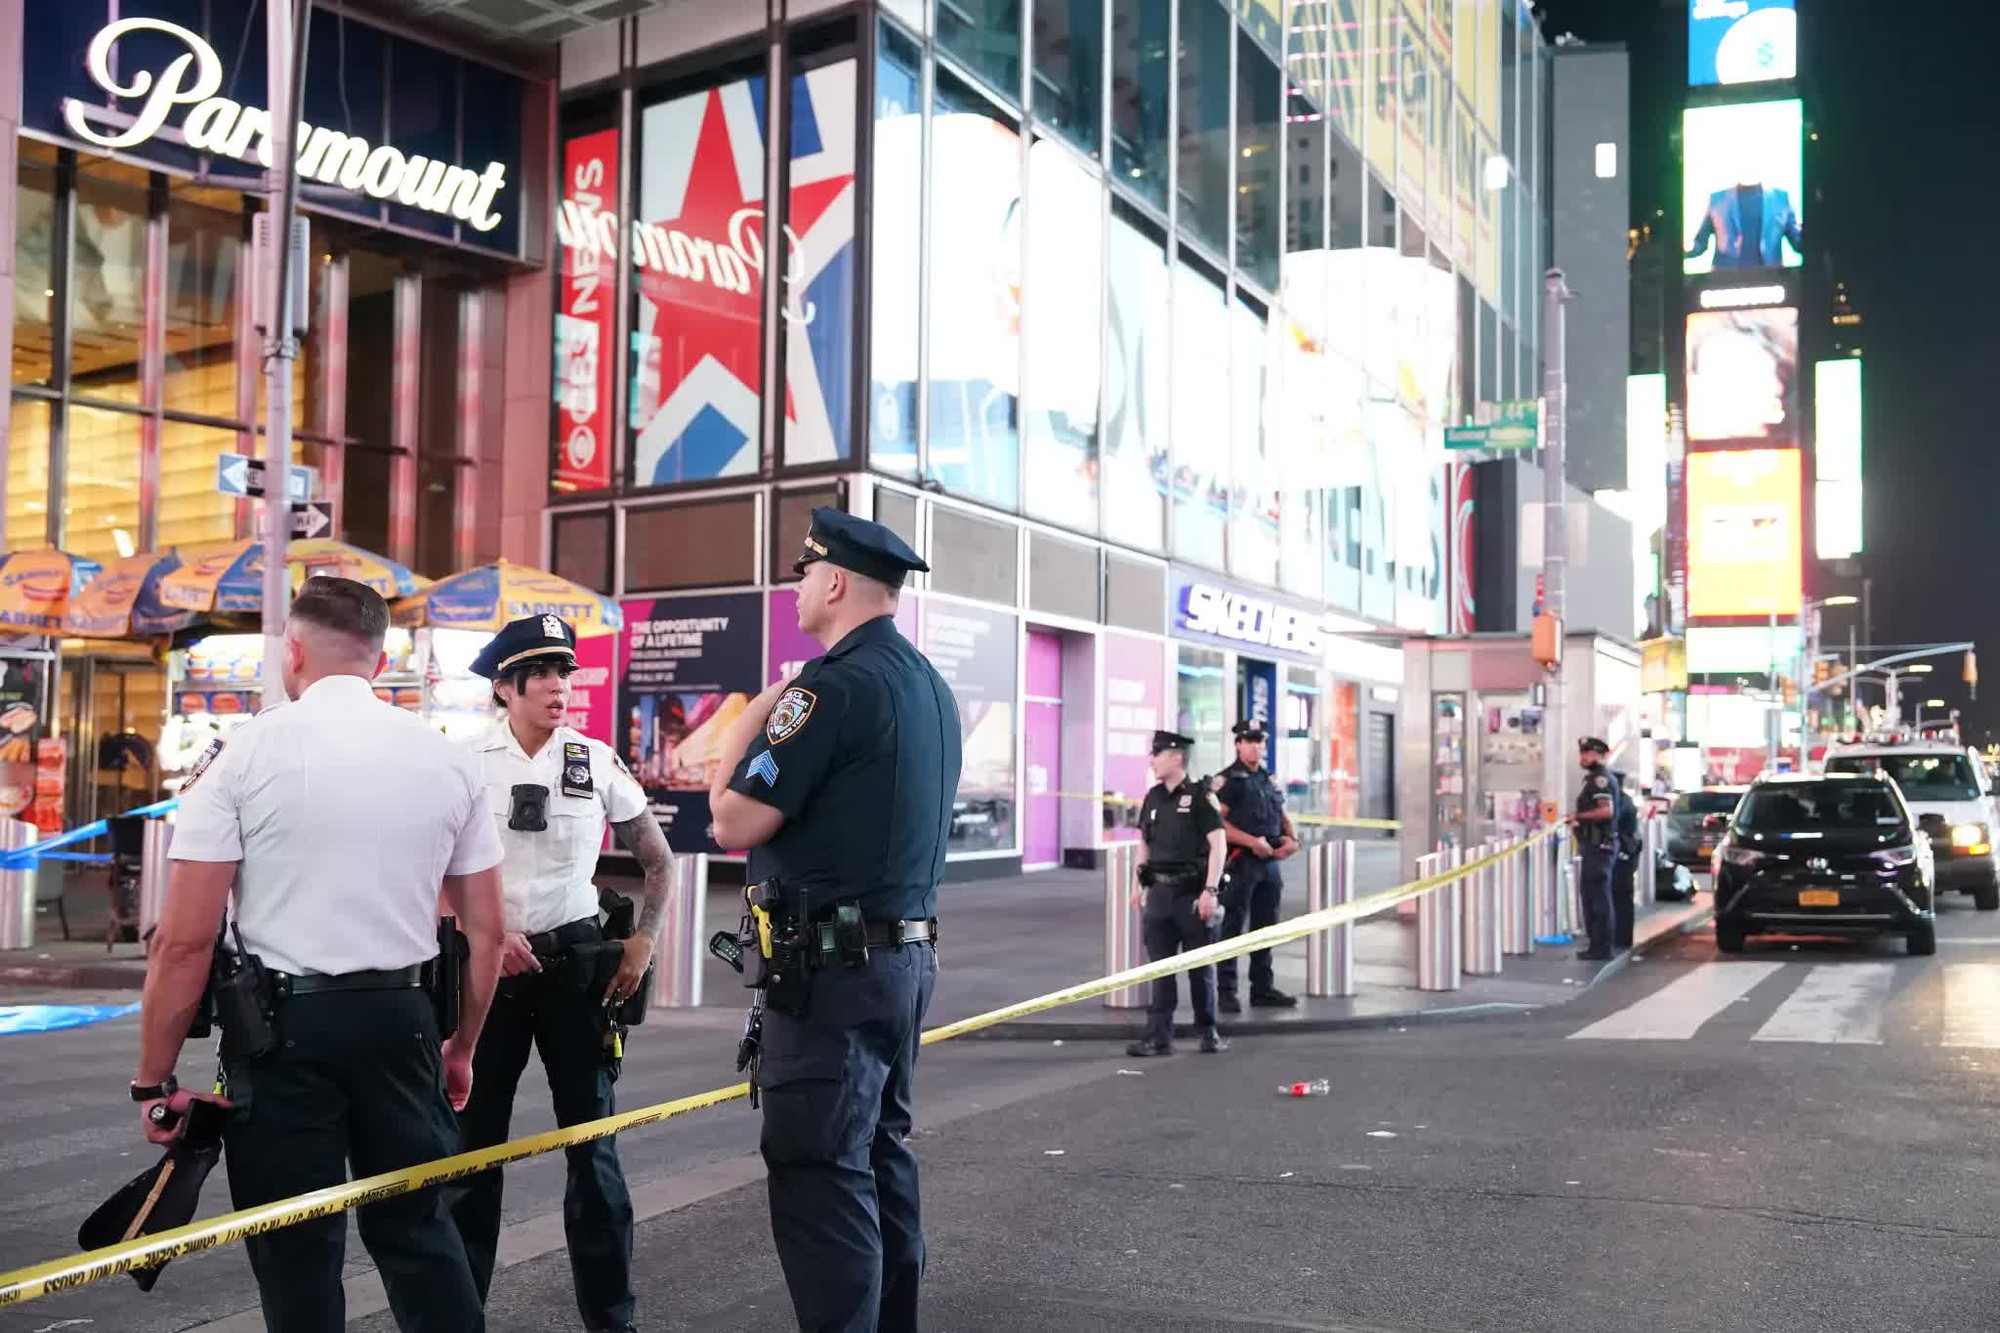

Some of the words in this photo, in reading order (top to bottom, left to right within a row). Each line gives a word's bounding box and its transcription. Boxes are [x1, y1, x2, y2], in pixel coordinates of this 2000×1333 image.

[63, 17, 507, 232] Paramount
[296, 514, 319, 528] WAY
[631, 621, 652, 635] THE
[653, 616, 729, 634] OPPORTUNITY
[1182, 583, 1324, 655] SKECHERS
[655, 632, 703, 648] LIFETIME
[779, 726, 793, 738] NEW
[791, 712, 807, 728] YORK
